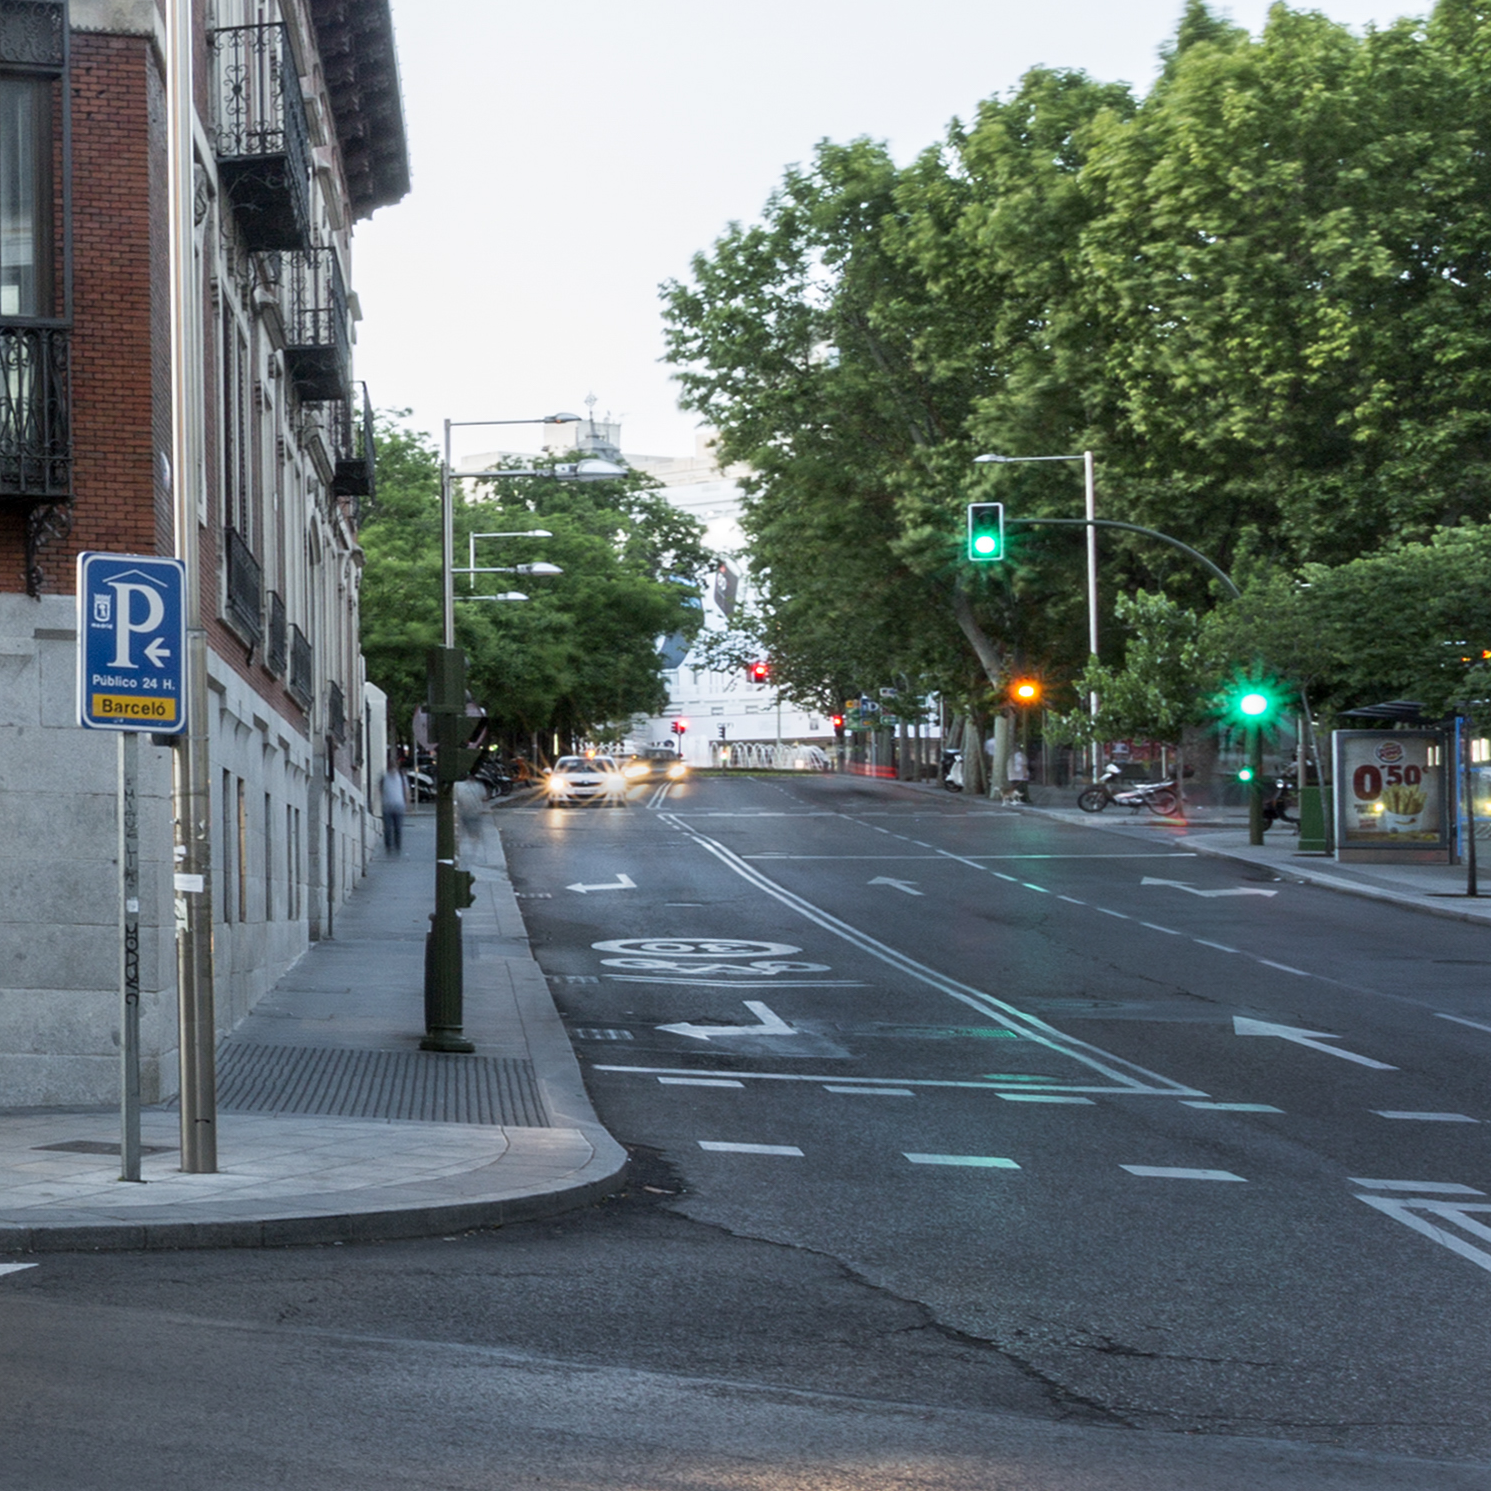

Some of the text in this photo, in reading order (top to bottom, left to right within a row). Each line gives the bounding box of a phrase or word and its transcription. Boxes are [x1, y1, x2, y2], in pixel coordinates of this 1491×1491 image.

[106, 582, 165, 668] P
[92, 674, 176, 690] Público 24 H.
[102, 698, 166, 716] Barceló
